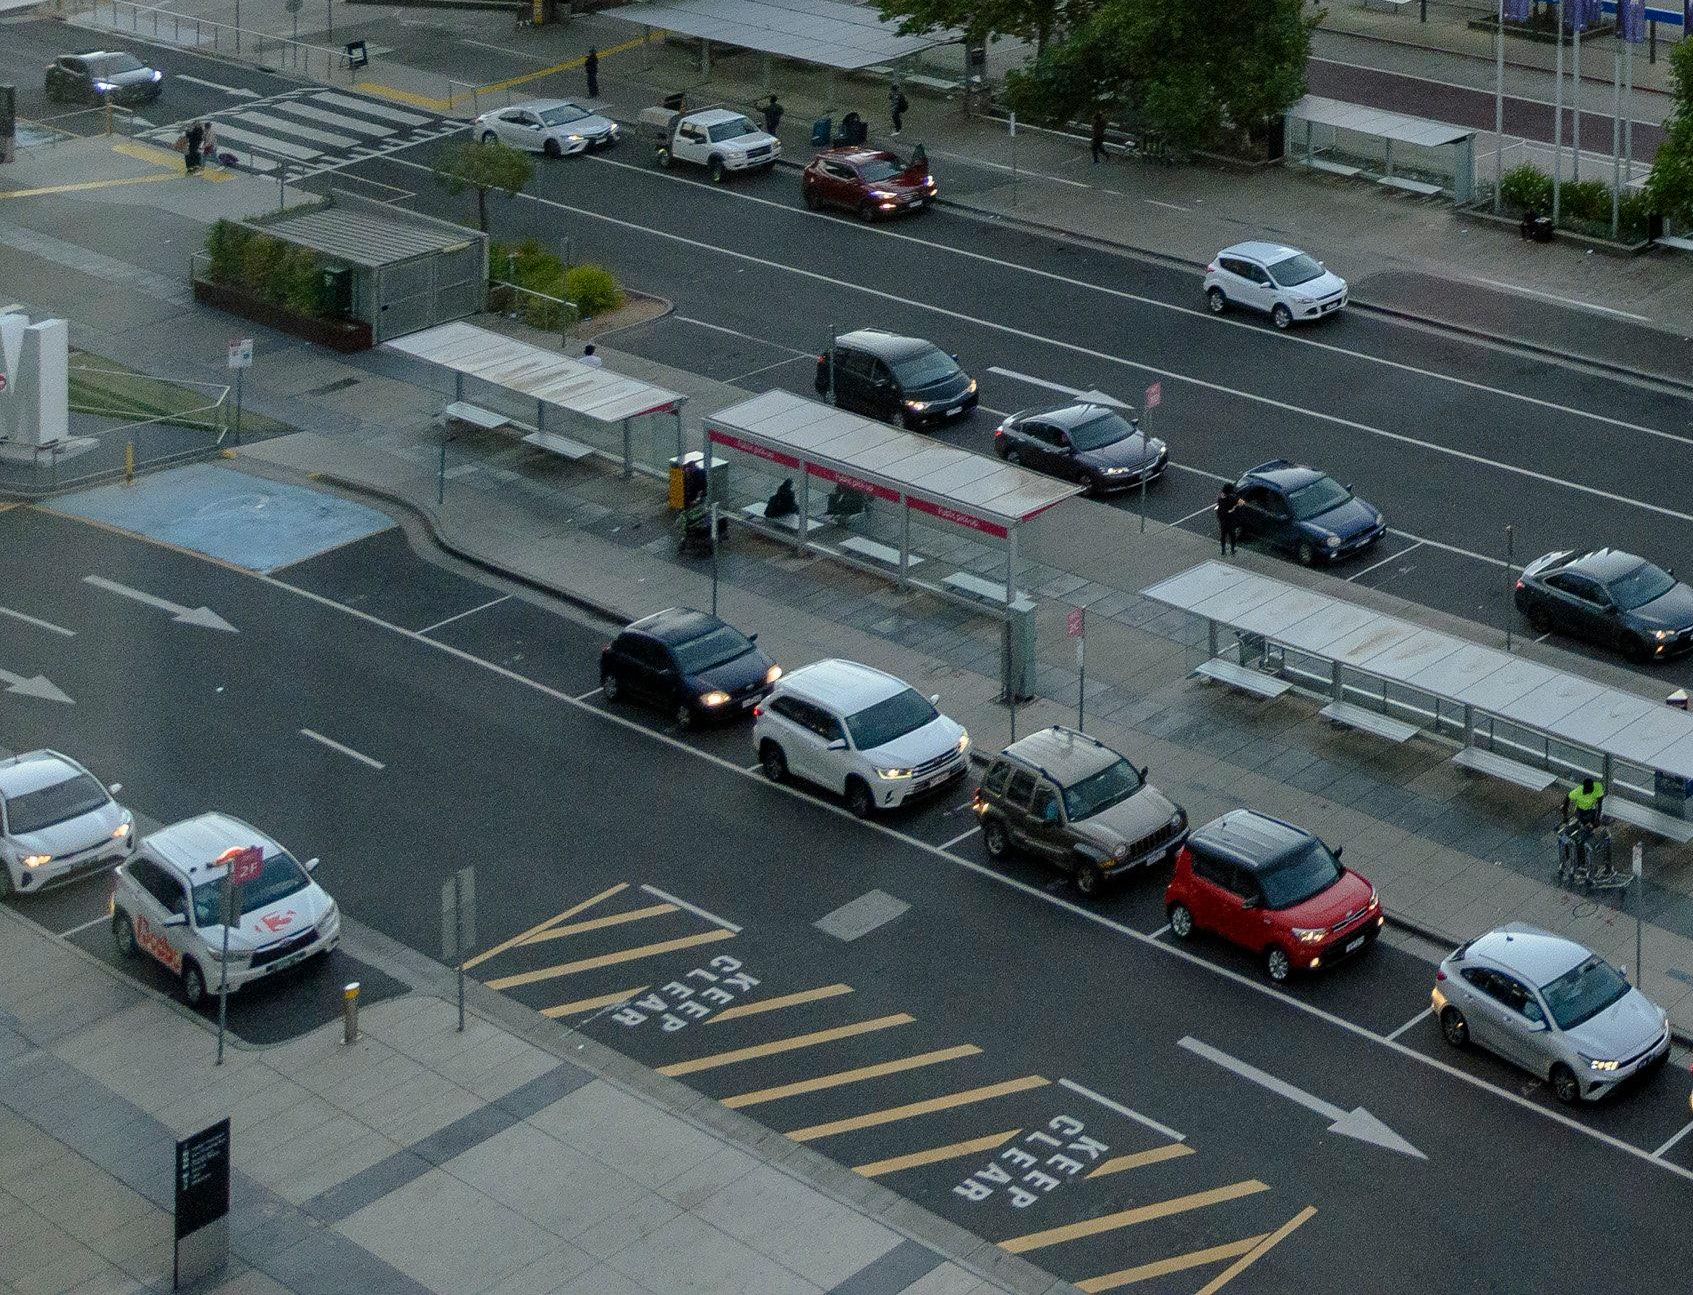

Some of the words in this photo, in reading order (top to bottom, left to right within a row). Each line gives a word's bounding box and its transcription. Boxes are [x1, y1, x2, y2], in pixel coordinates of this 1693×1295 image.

[611, 955, 743, 1026] CLEAR
[661, 972, 762, 1032] KEEP
[952, 1115, 1085, 1201] CLEAR
[1007, 1134, 1110, 1208] KEEP
